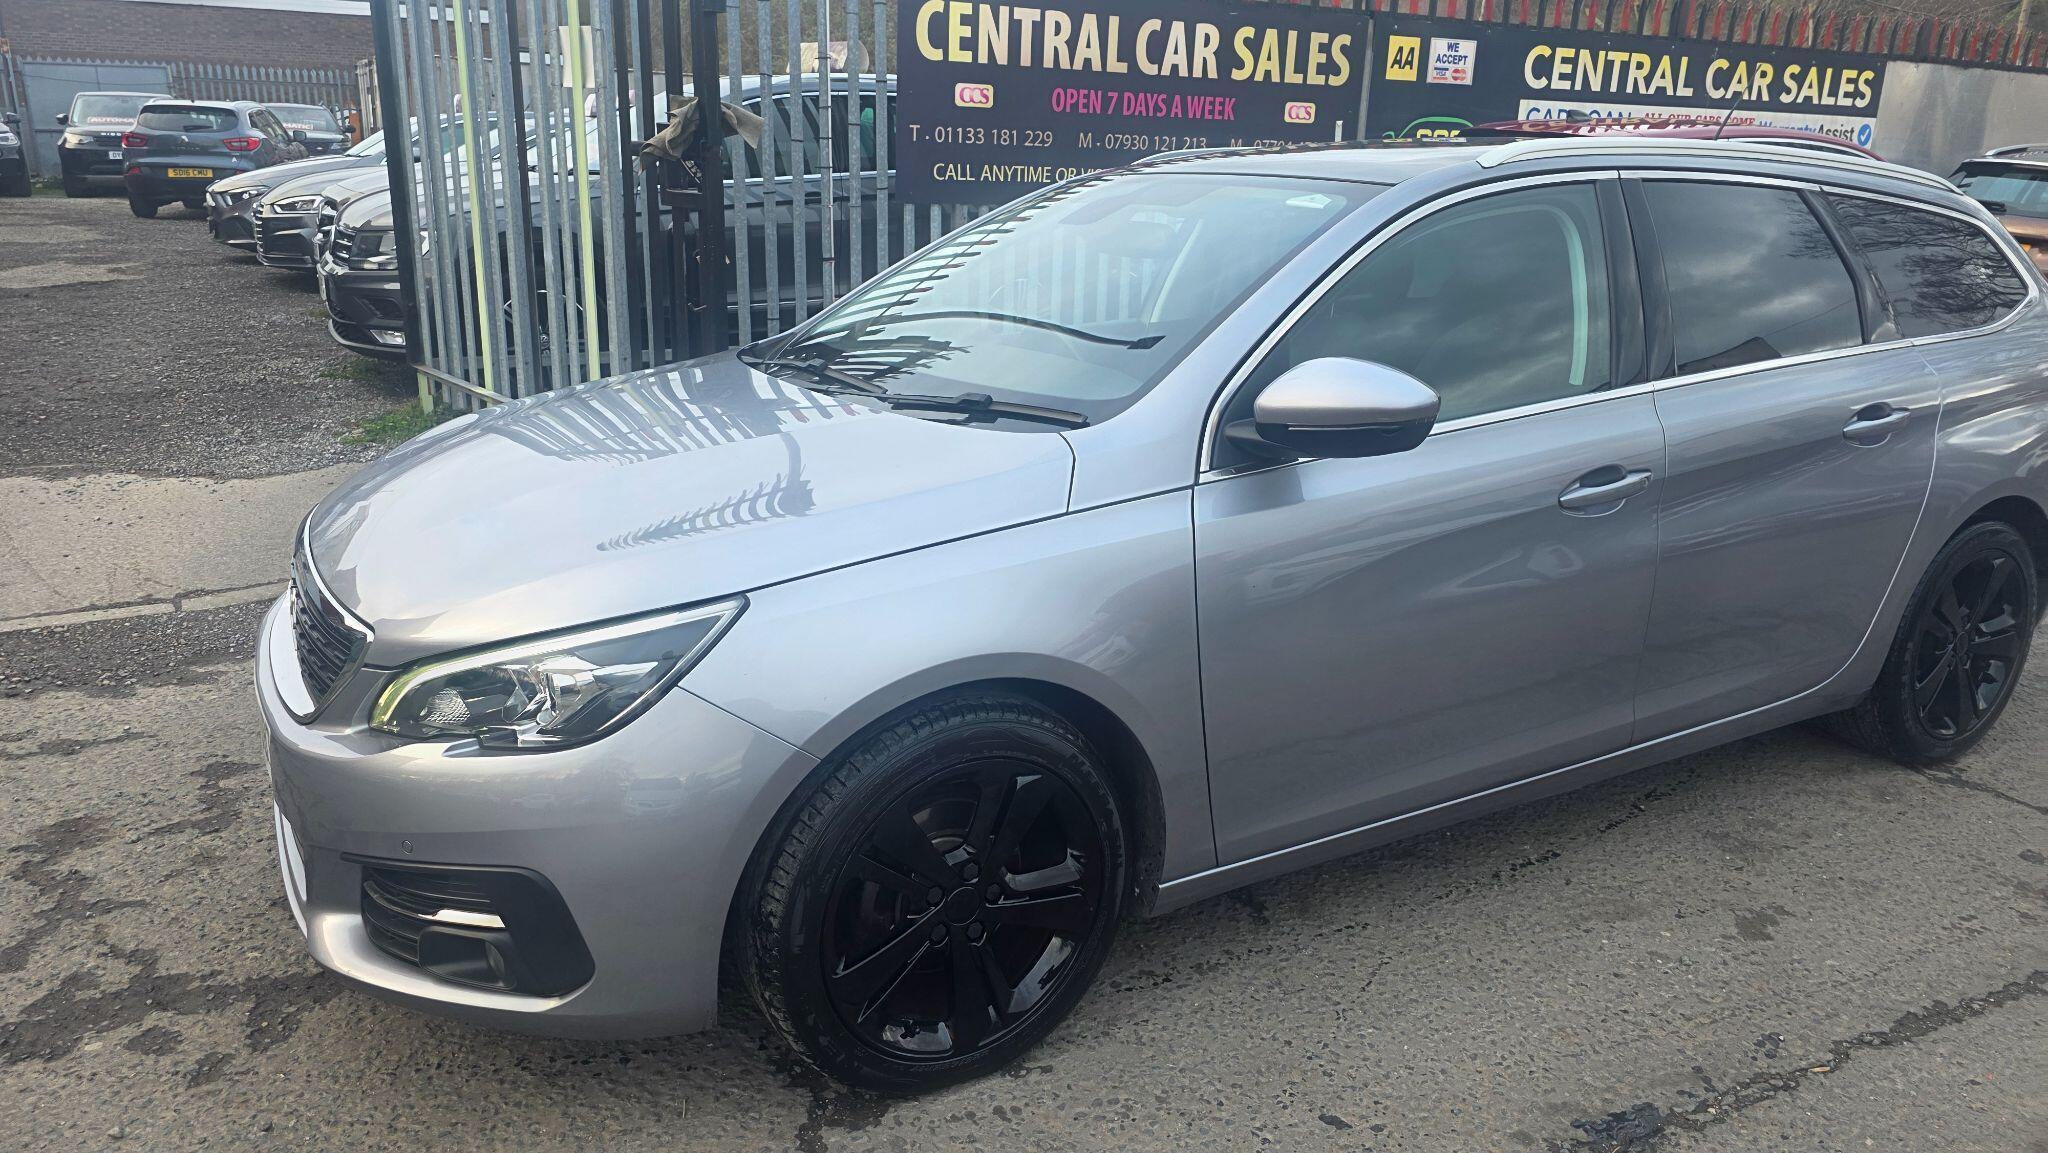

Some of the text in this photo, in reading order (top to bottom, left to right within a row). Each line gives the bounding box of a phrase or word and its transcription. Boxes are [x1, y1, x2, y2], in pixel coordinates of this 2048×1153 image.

[916, 0, 1352, 87] CENTRAL CAR SALES
[1447, 42, 1460, 53] WE
[1391, 46, 1415, 70] AA
[1435, 54, 1468, 65] ACCEPT
[1524, 45, 1875, 108] CENTRAL CAR SALES
[1052, 87, 1236, 121] OPEN 7 DAYS A WEEK
[935, 126, 985, 144] 01133
[992, 129, 1017, 146] 181
[1024, 131, 1053, 147] 229
[1105, 134, 1149, 150] 07930
[1154, 136, 1177, 151] 121
[1183, 137, 1207, 150] 213
[934, 163, 975, 181] CALL
[981, 164, 1051, 183] ANYTIME
[1056, 167, 1077, 183] OR
